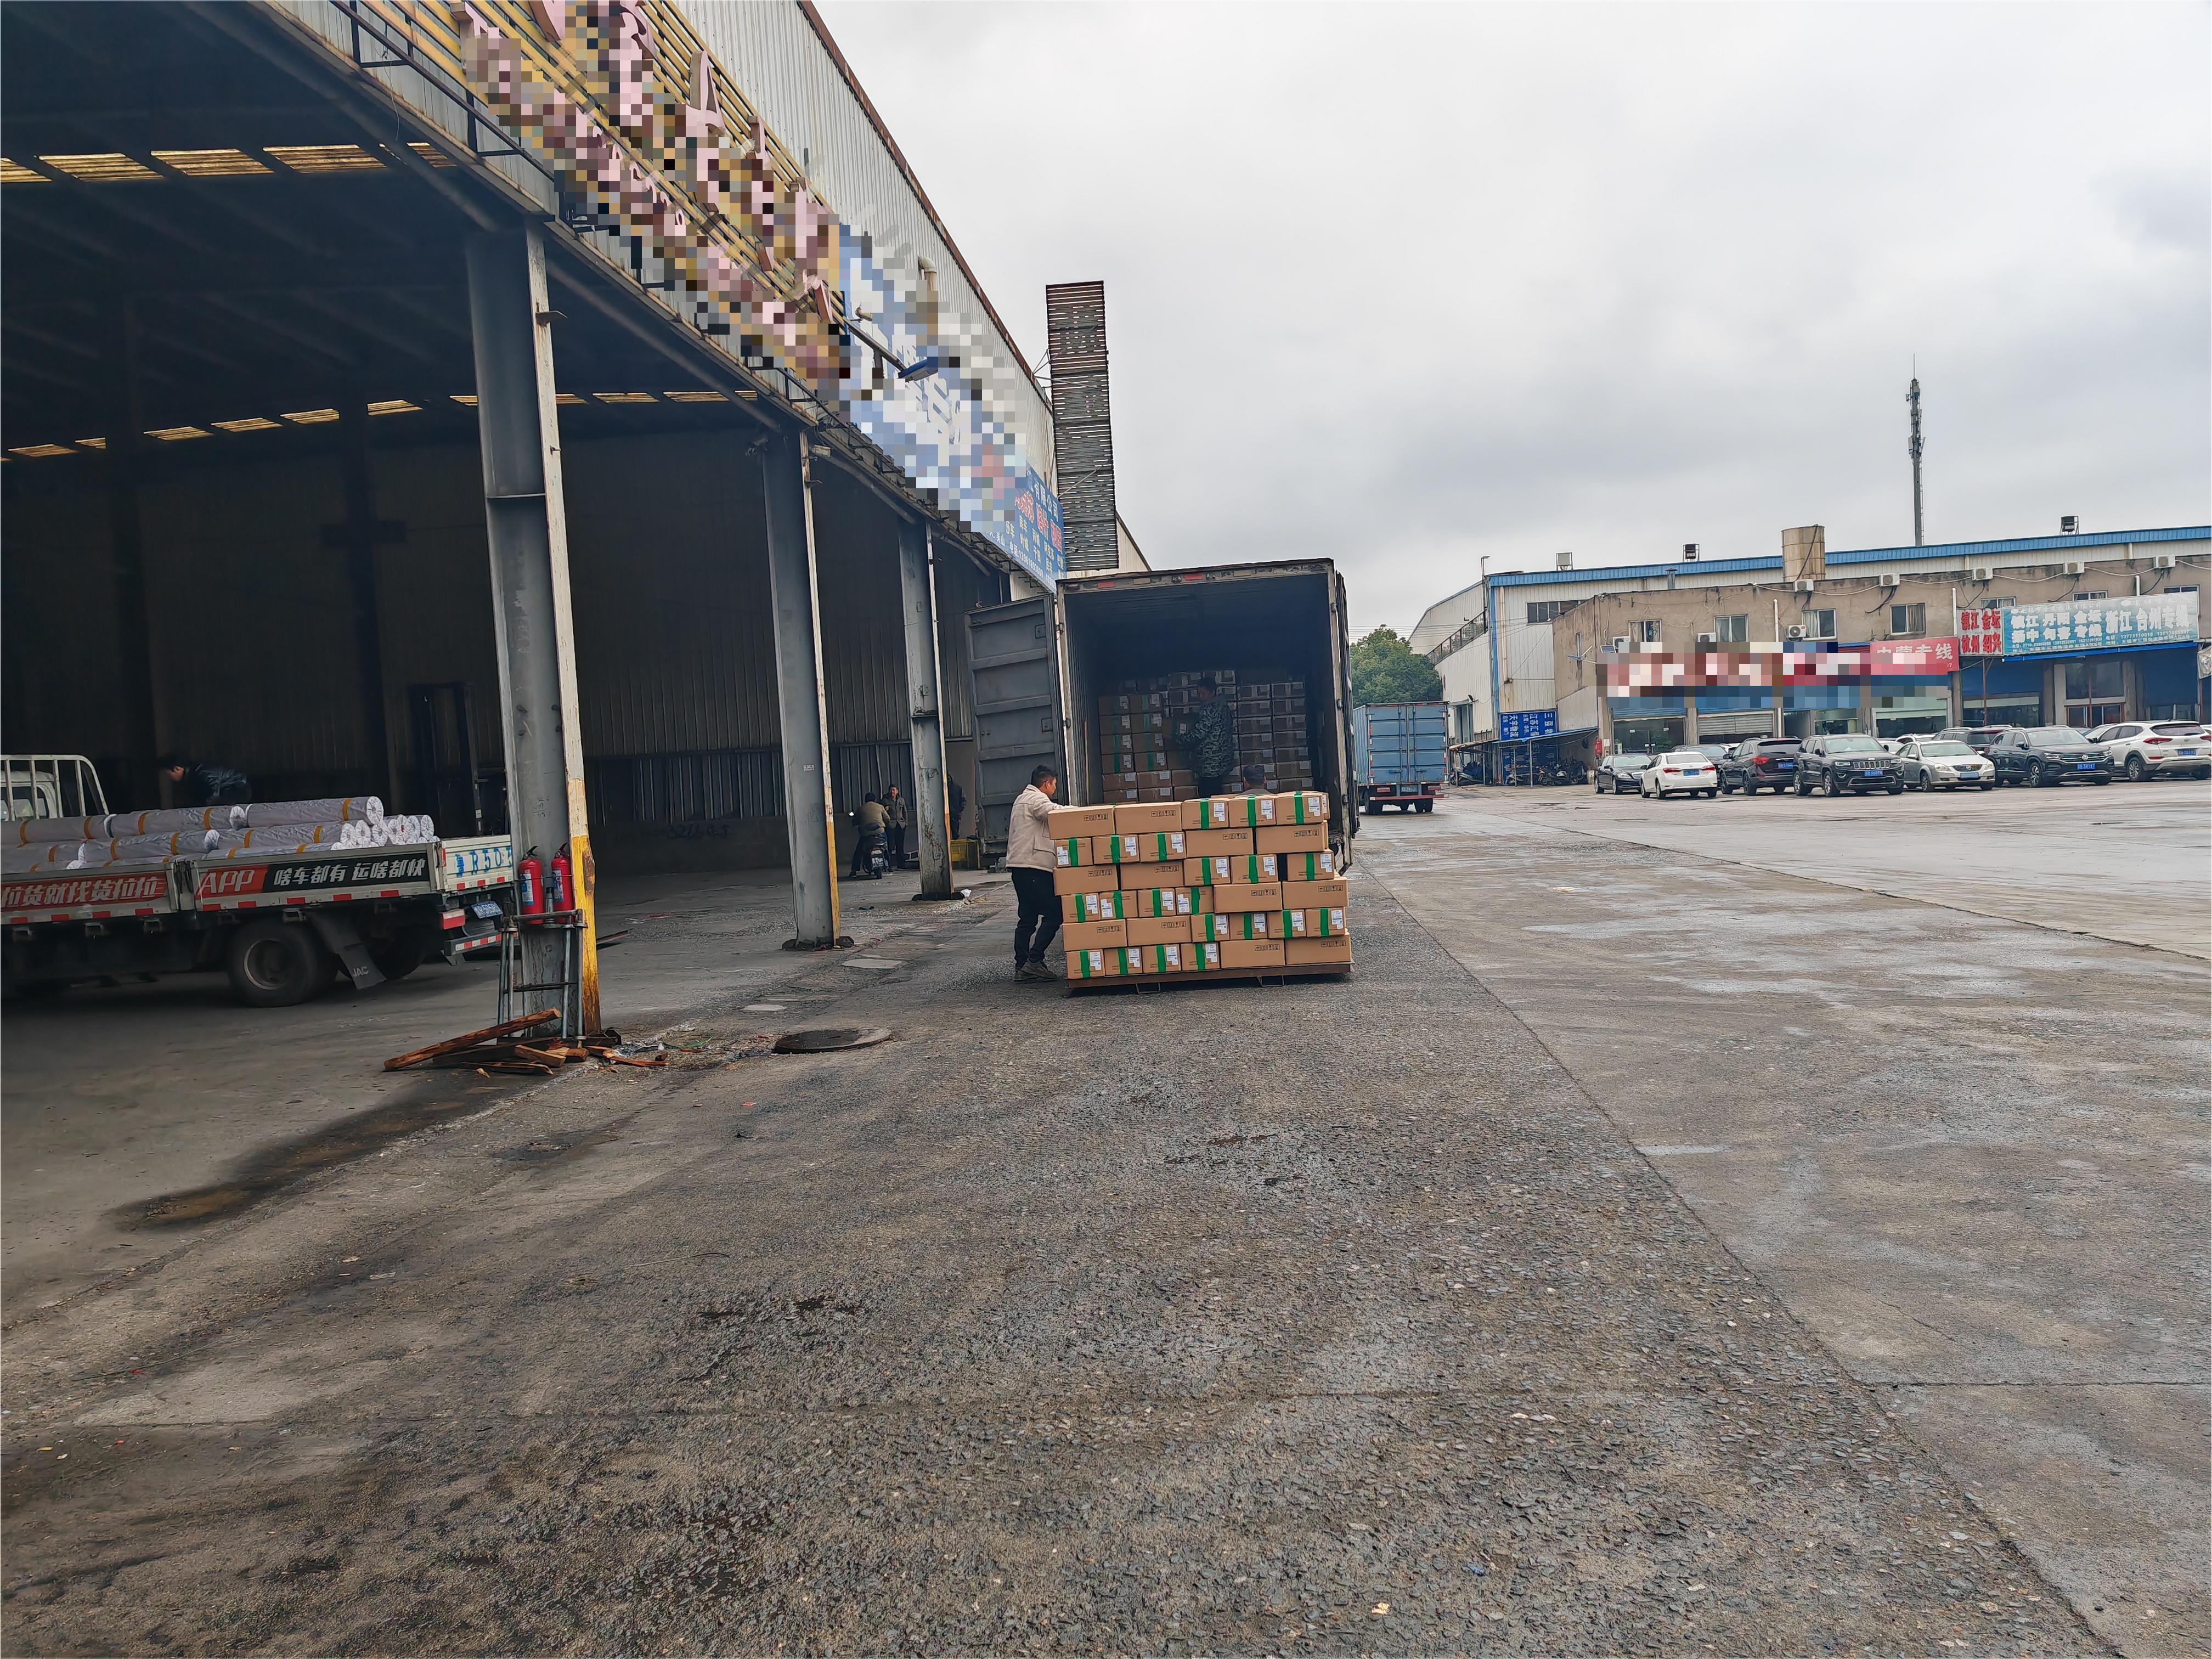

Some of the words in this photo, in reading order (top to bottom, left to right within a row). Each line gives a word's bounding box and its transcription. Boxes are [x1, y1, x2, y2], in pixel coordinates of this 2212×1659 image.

[1961, 611, 1979, 630] 镇江
[1982, 610, 2001, 630] 金坛
[2042, 612, 2070, 627] 丹阳
[2105, 610, 2133, 634] 浙江
[1961, 635, 1979, 653] 杭州
[1983, 633, 2001, 653] 绍兴
[199, 869, 255, 893] APP
[273, 864, 348, 887] 啥车都有
[352, 858, 426, 881] 运啥都快
[1, 876, 158, 907] 拉货就找货拉拉
[352, 966, 369, 977] JAC
